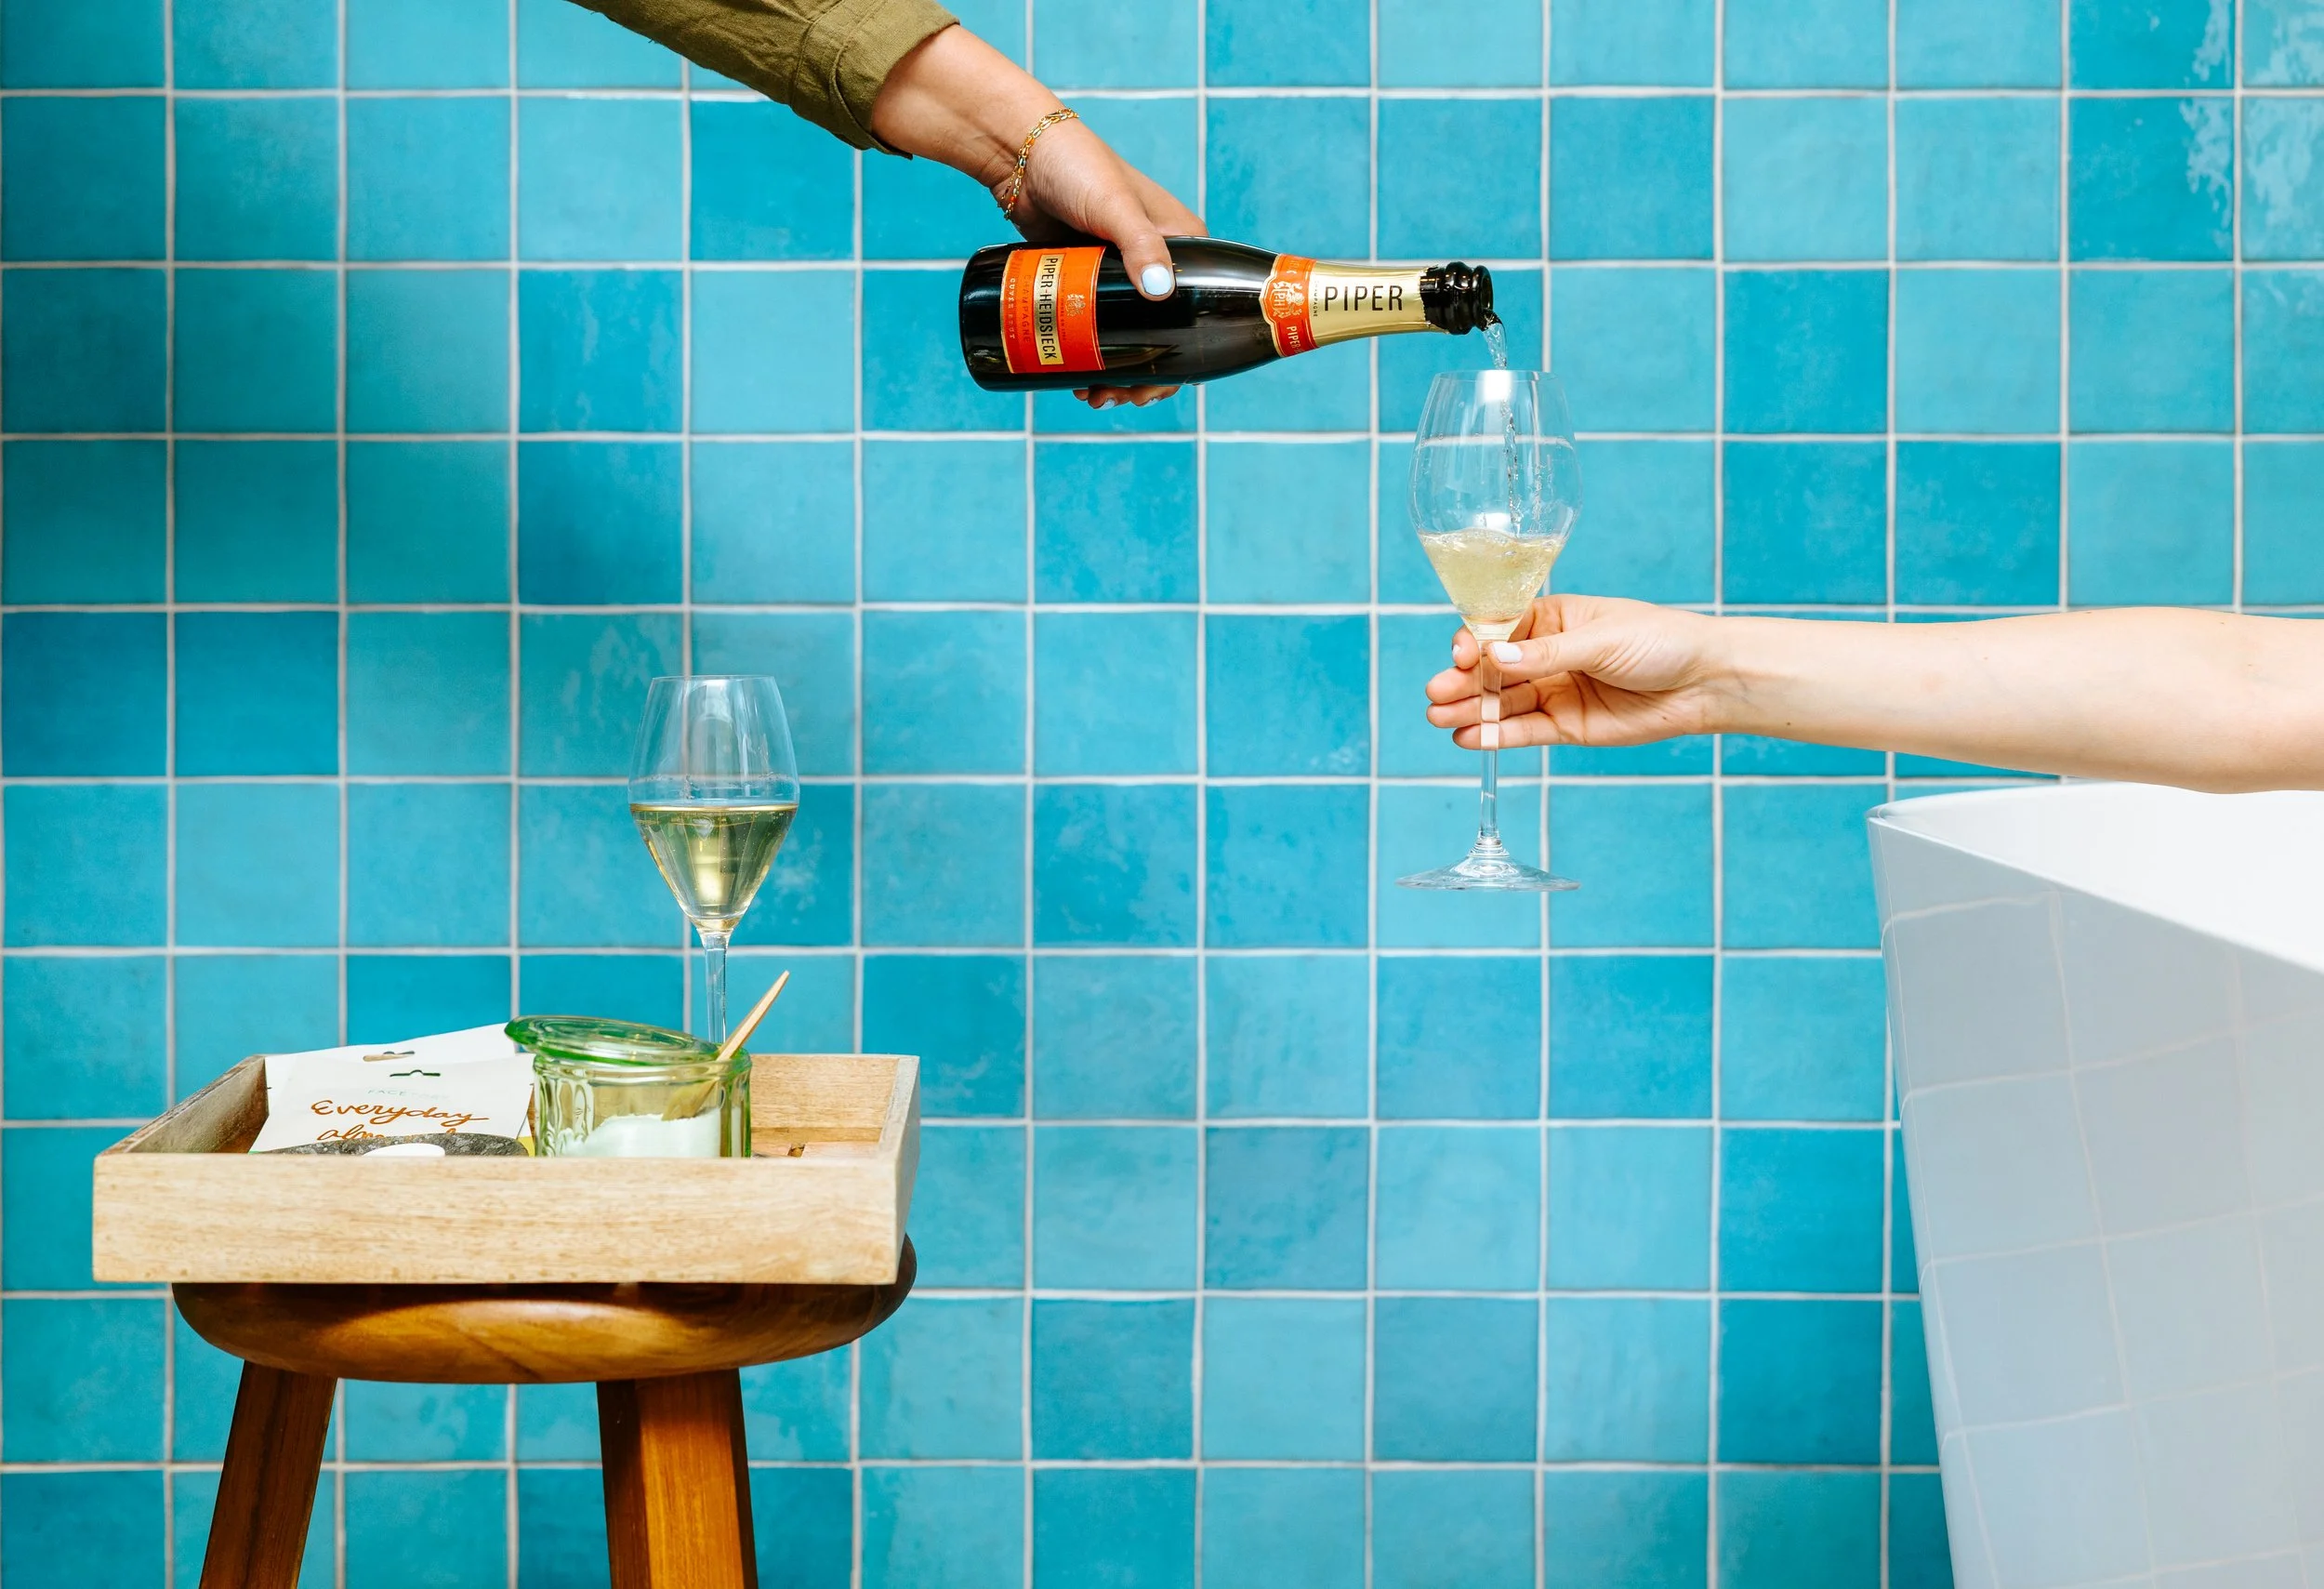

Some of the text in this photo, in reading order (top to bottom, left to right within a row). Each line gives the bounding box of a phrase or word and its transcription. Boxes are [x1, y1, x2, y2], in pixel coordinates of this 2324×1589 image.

[1022, 274, 1031, 343] CHAMPAGNE
[1039, 258, 1058, 359] PIPER-HEIDSIECK
[1324, 285, 1403, 311] PIPER
[310, 1100, 490, 1128] Everyday
